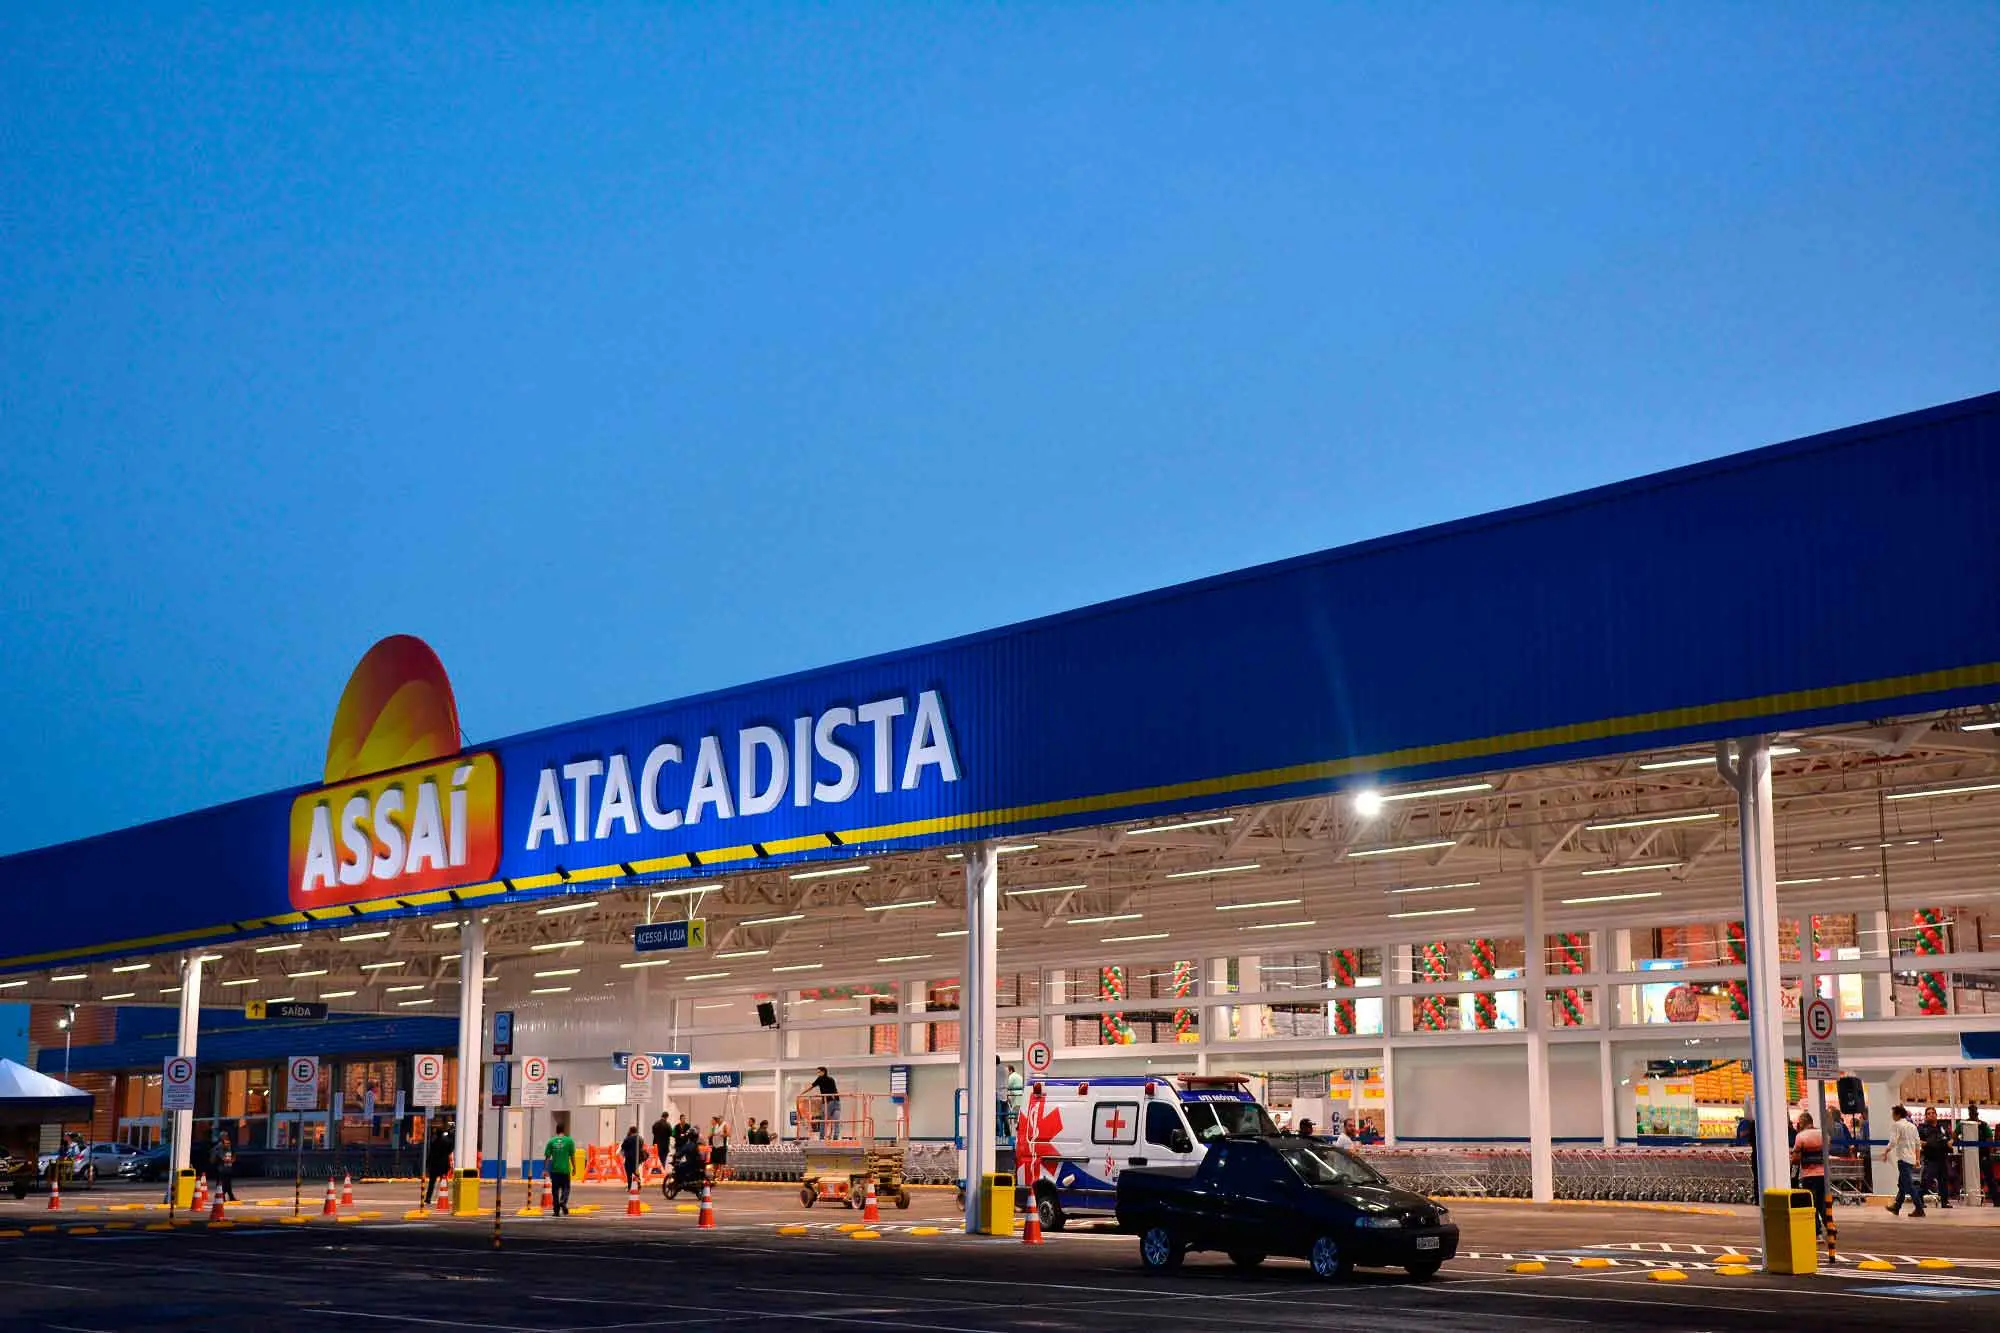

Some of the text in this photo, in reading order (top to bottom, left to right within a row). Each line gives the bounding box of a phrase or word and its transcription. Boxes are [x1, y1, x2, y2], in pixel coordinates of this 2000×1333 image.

[525, 689, 961, 851] ATACADISTA
[637, 931, 662, 945] ACESSO
[669, 928, 686, 942] LOJA
[281, 1004, 311, 1016] SAÍDA
[1815, 1010, 1826, 1031] E
[1034, 1049, 1045, 1065] E
[175, 1064, 185, 1078] E
[298, 1064, 309, 1078] E
[424, 1062, 434, 1076] E
[531, 1064, 540, 1077] E
[636, 1063, 645, 1076] E
[707, 1074, 732, 1085] ENTRADA
